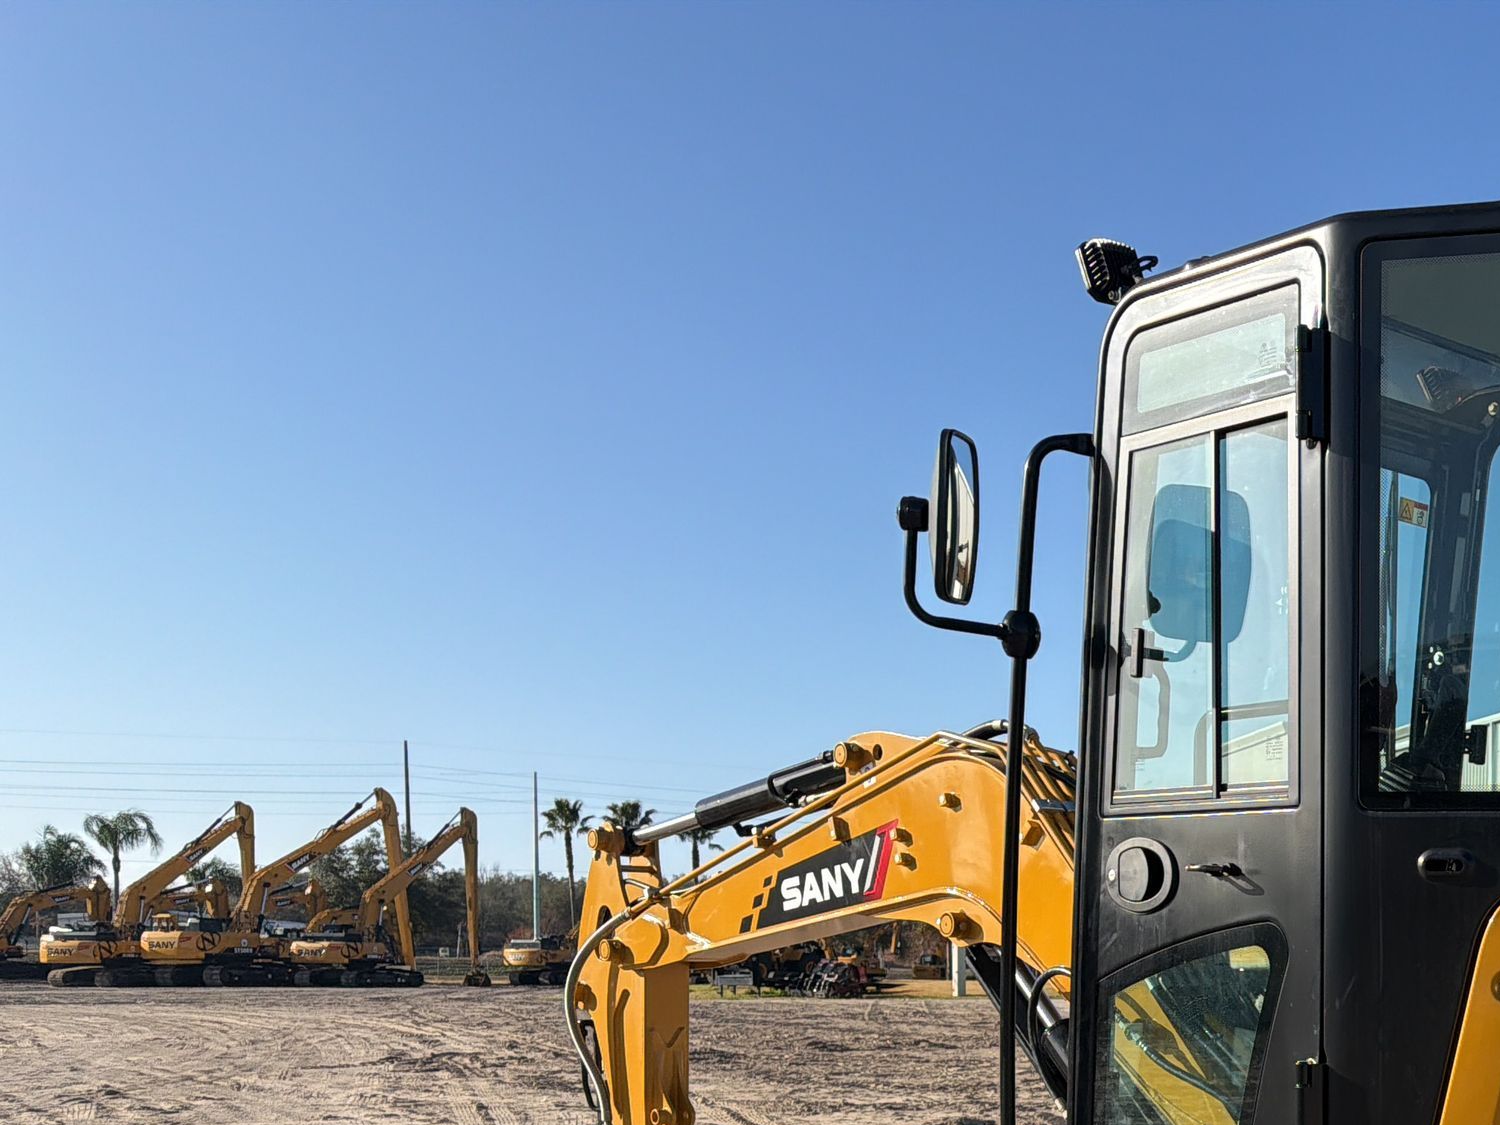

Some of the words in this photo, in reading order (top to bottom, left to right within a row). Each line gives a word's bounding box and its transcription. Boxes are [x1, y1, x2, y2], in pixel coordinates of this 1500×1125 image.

[781, 858, 865, 912] SANY
[147, 940, 176, 949] SANY
[47, 947, 74, 956] SANY
